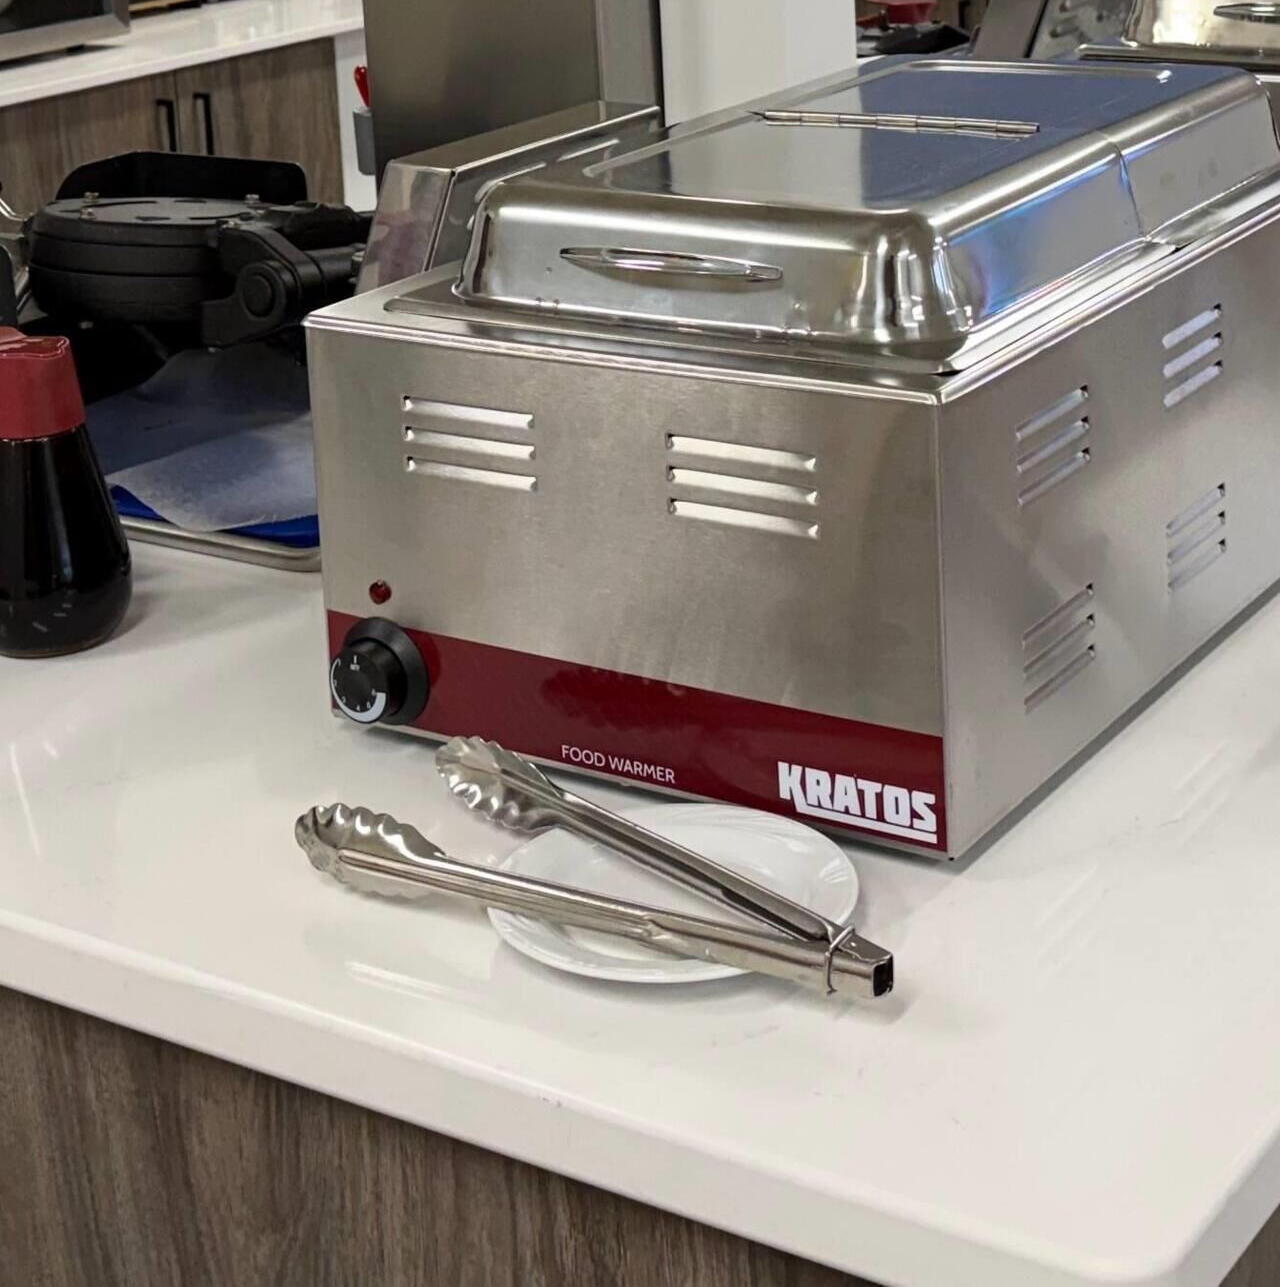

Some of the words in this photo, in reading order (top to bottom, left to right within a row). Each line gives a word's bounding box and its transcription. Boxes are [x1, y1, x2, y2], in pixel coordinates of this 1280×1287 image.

[561, 745, 606, 769] FOOD
[608, 755, 676, 785] WARMER
[777, 762, 938, 843] KRATOS
